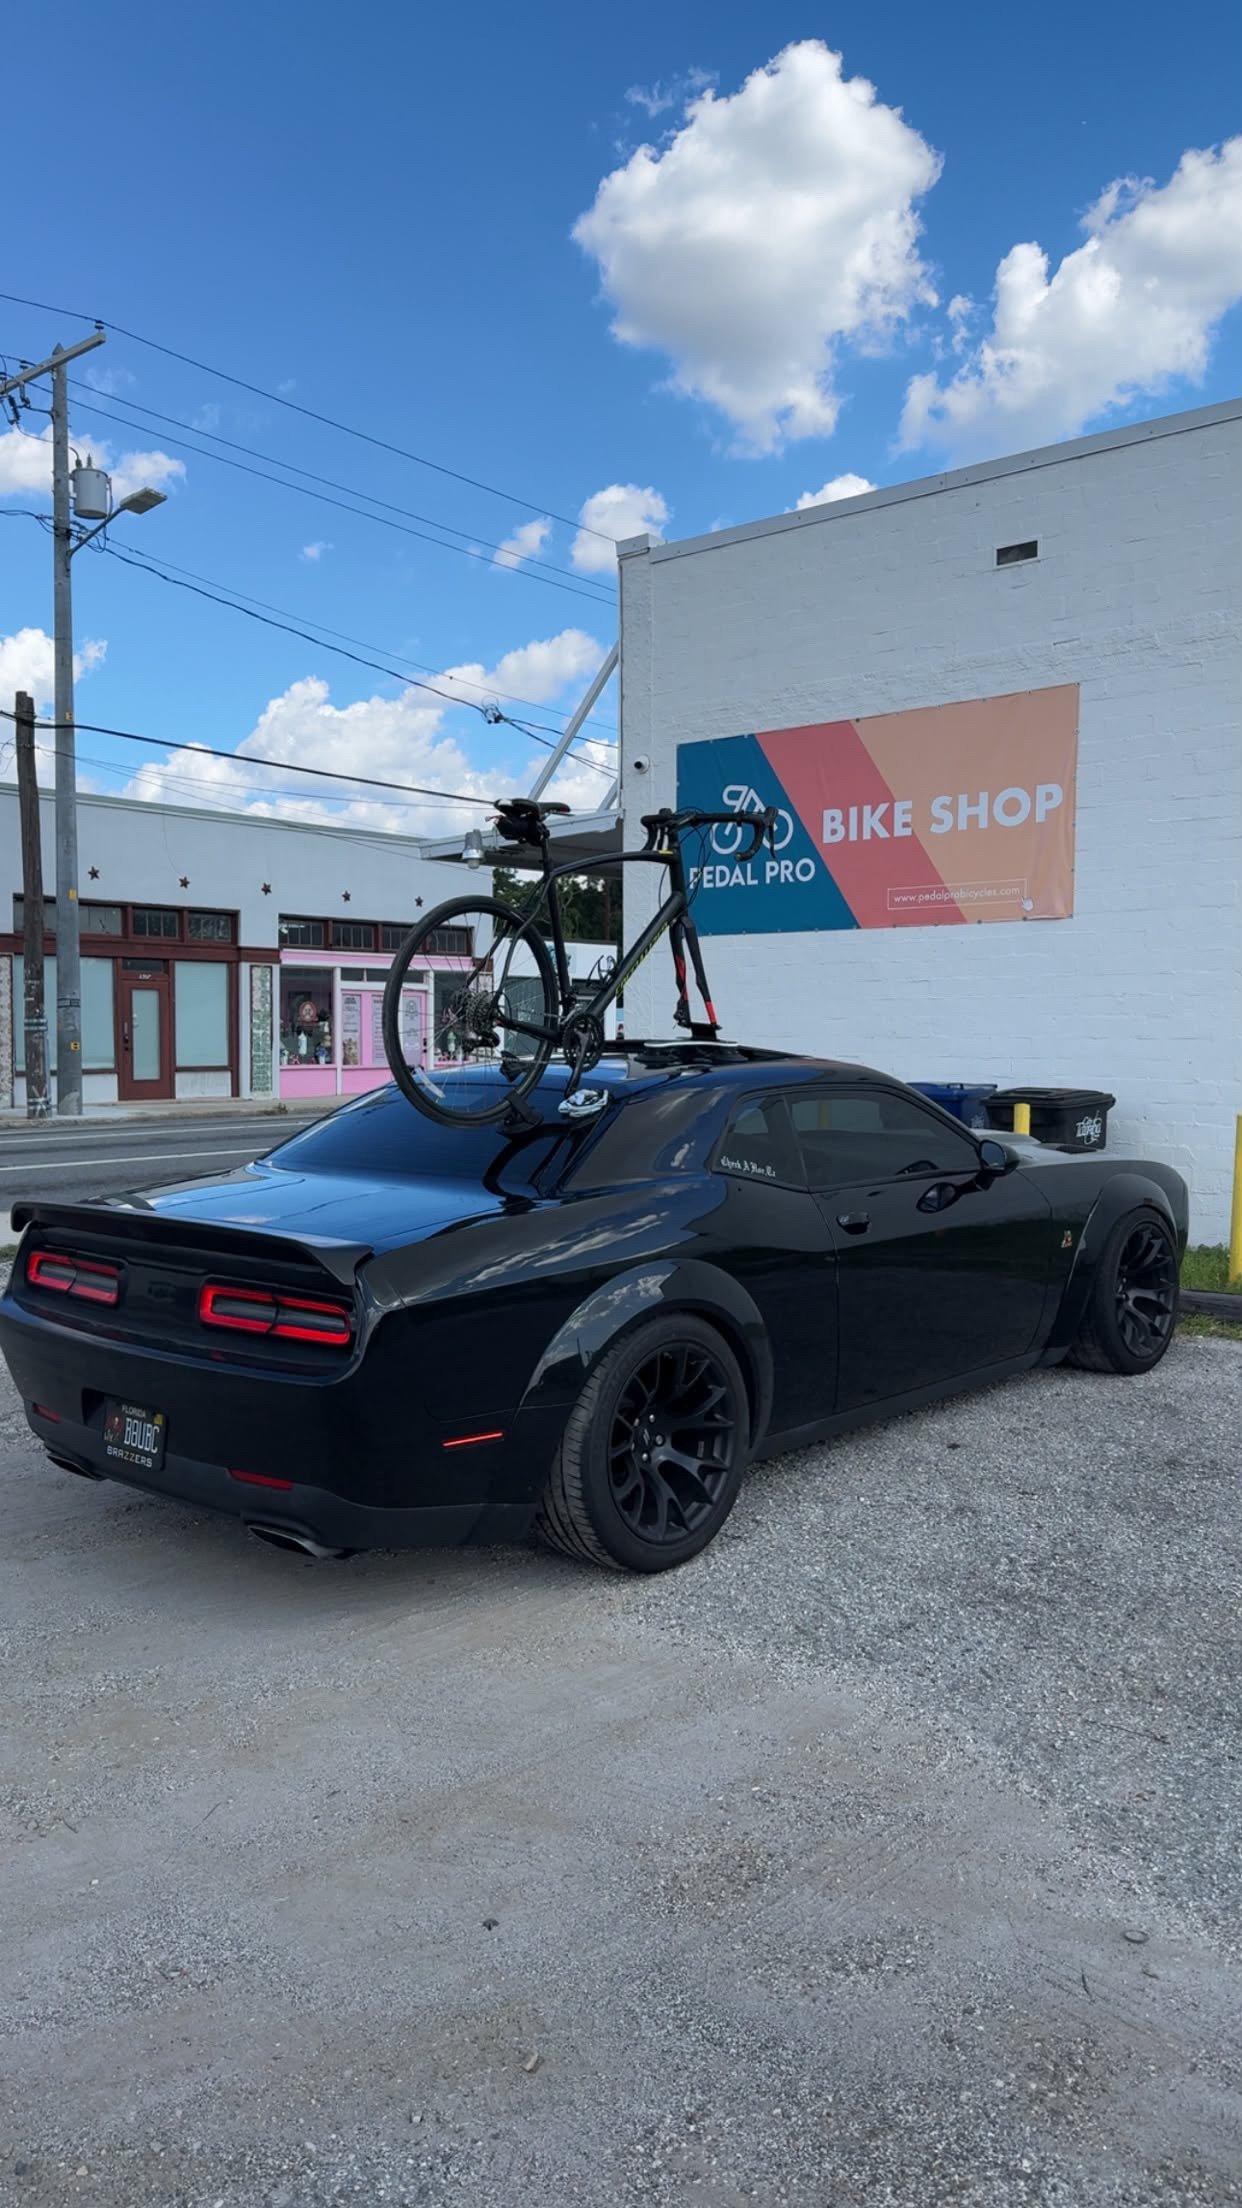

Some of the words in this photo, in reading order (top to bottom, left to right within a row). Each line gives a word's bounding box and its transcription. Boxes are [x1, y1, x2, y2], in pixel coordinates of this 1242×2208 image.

[823, 800, 913, 844] BIKE
[930, 784, 1063, 834] SHOP
[689, 863, 758, 889] PEDAL
[765, 858, 816, 884] PRO
[893, 887, 1020, 904] www.pedalprobicycles.com
[107, 1445, 153, 1468] BRAZZERS
